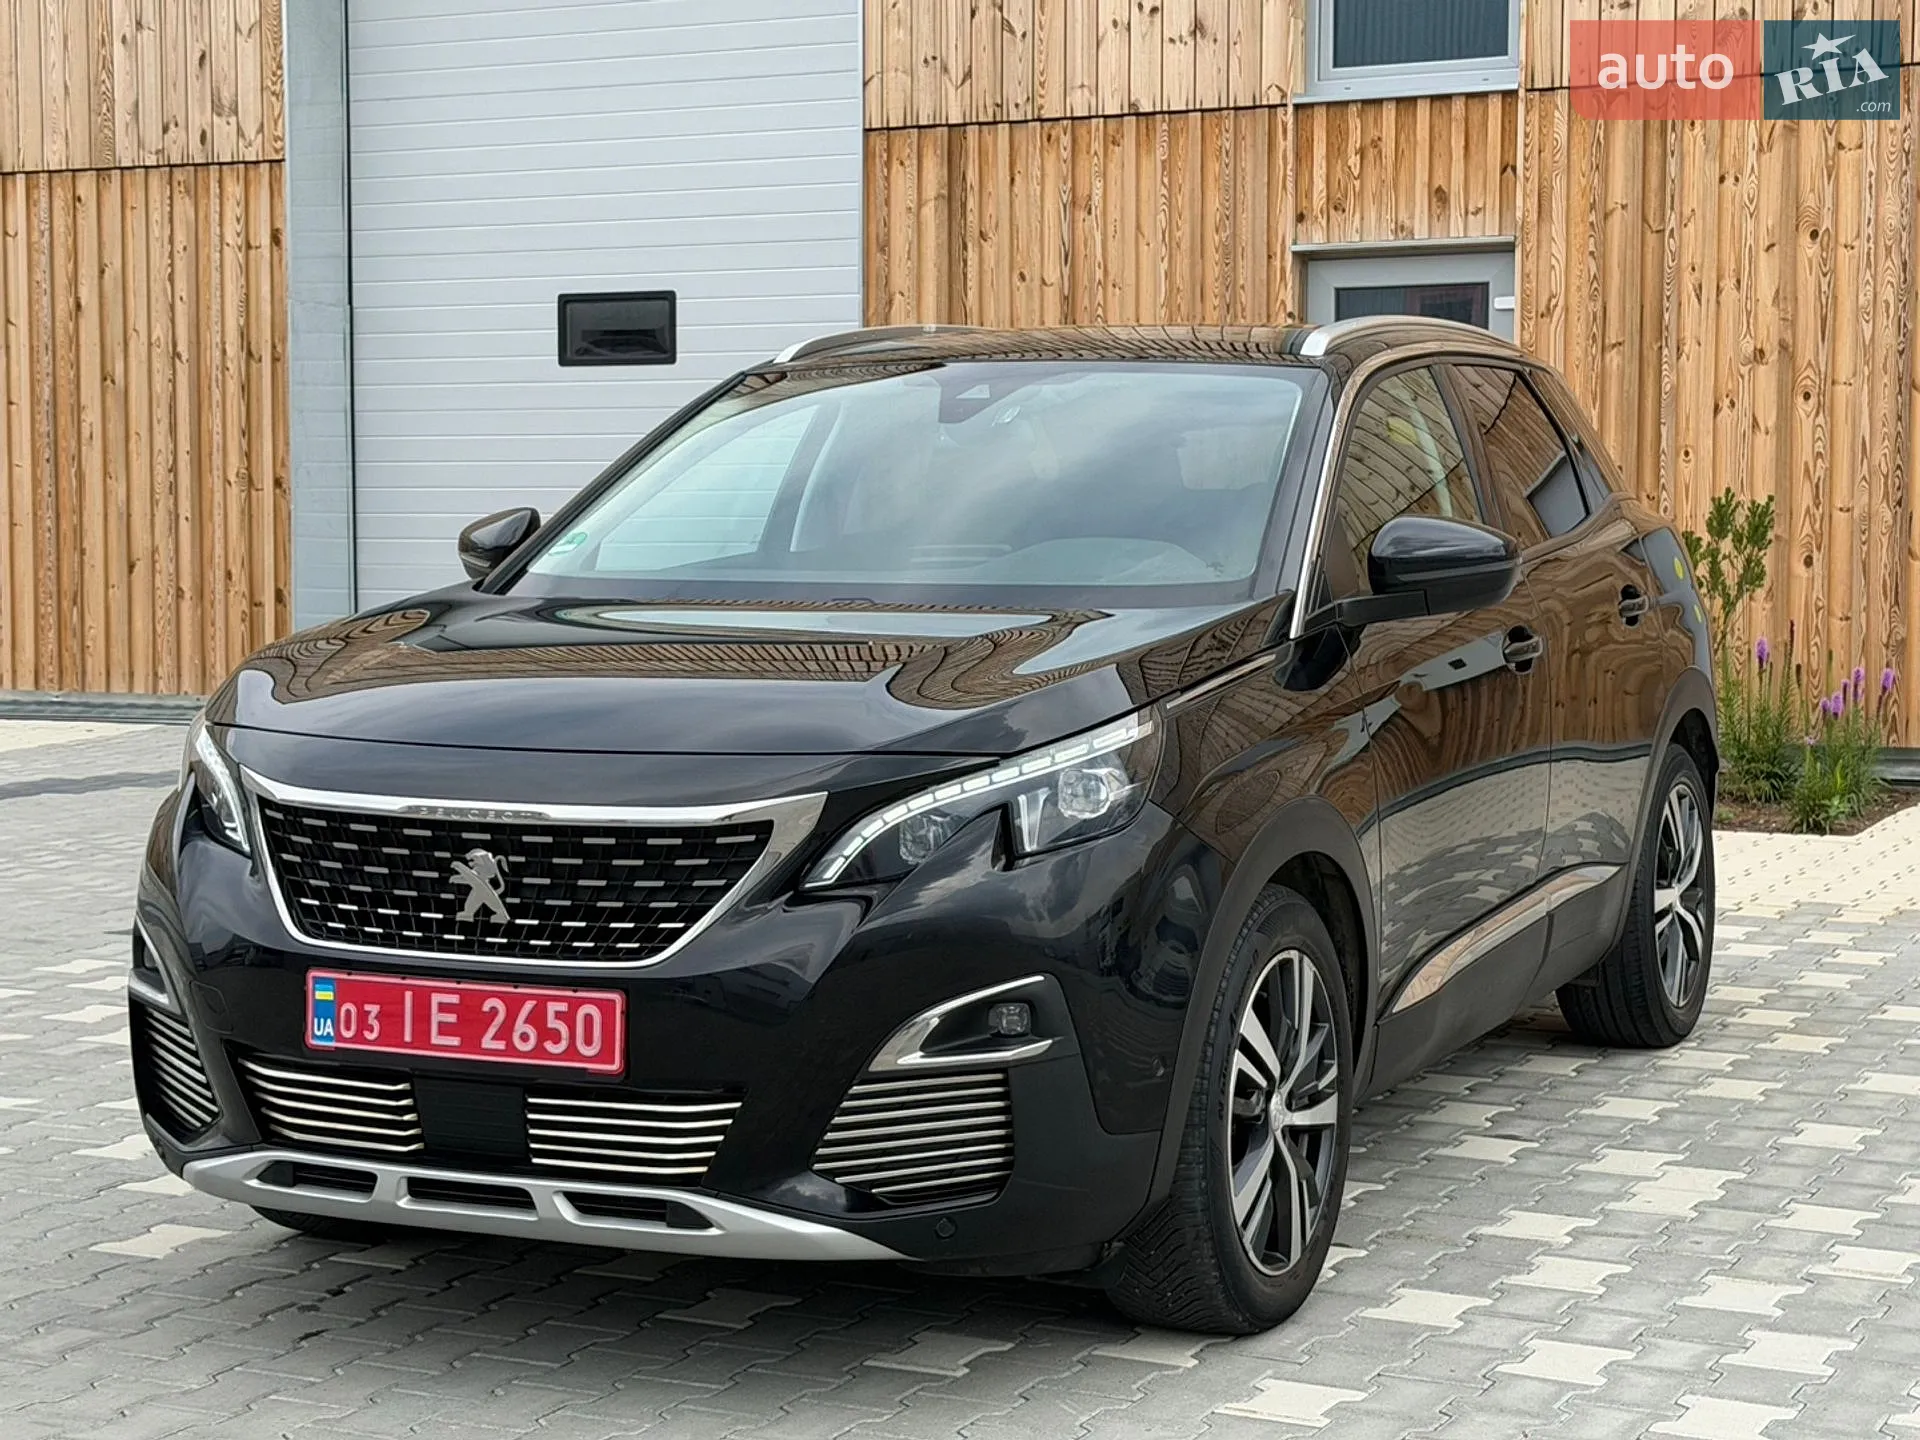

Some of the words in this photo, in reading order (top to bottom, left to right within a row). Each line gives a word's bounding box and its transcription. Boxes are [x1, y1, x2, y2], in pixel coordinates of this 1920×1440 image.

[313, 1017, 335, 1037] UA
[340, 1002, 380, 1040] 03
[403, 990, 461, 1047] IE
[480, 997, 603, 1058] 2650
